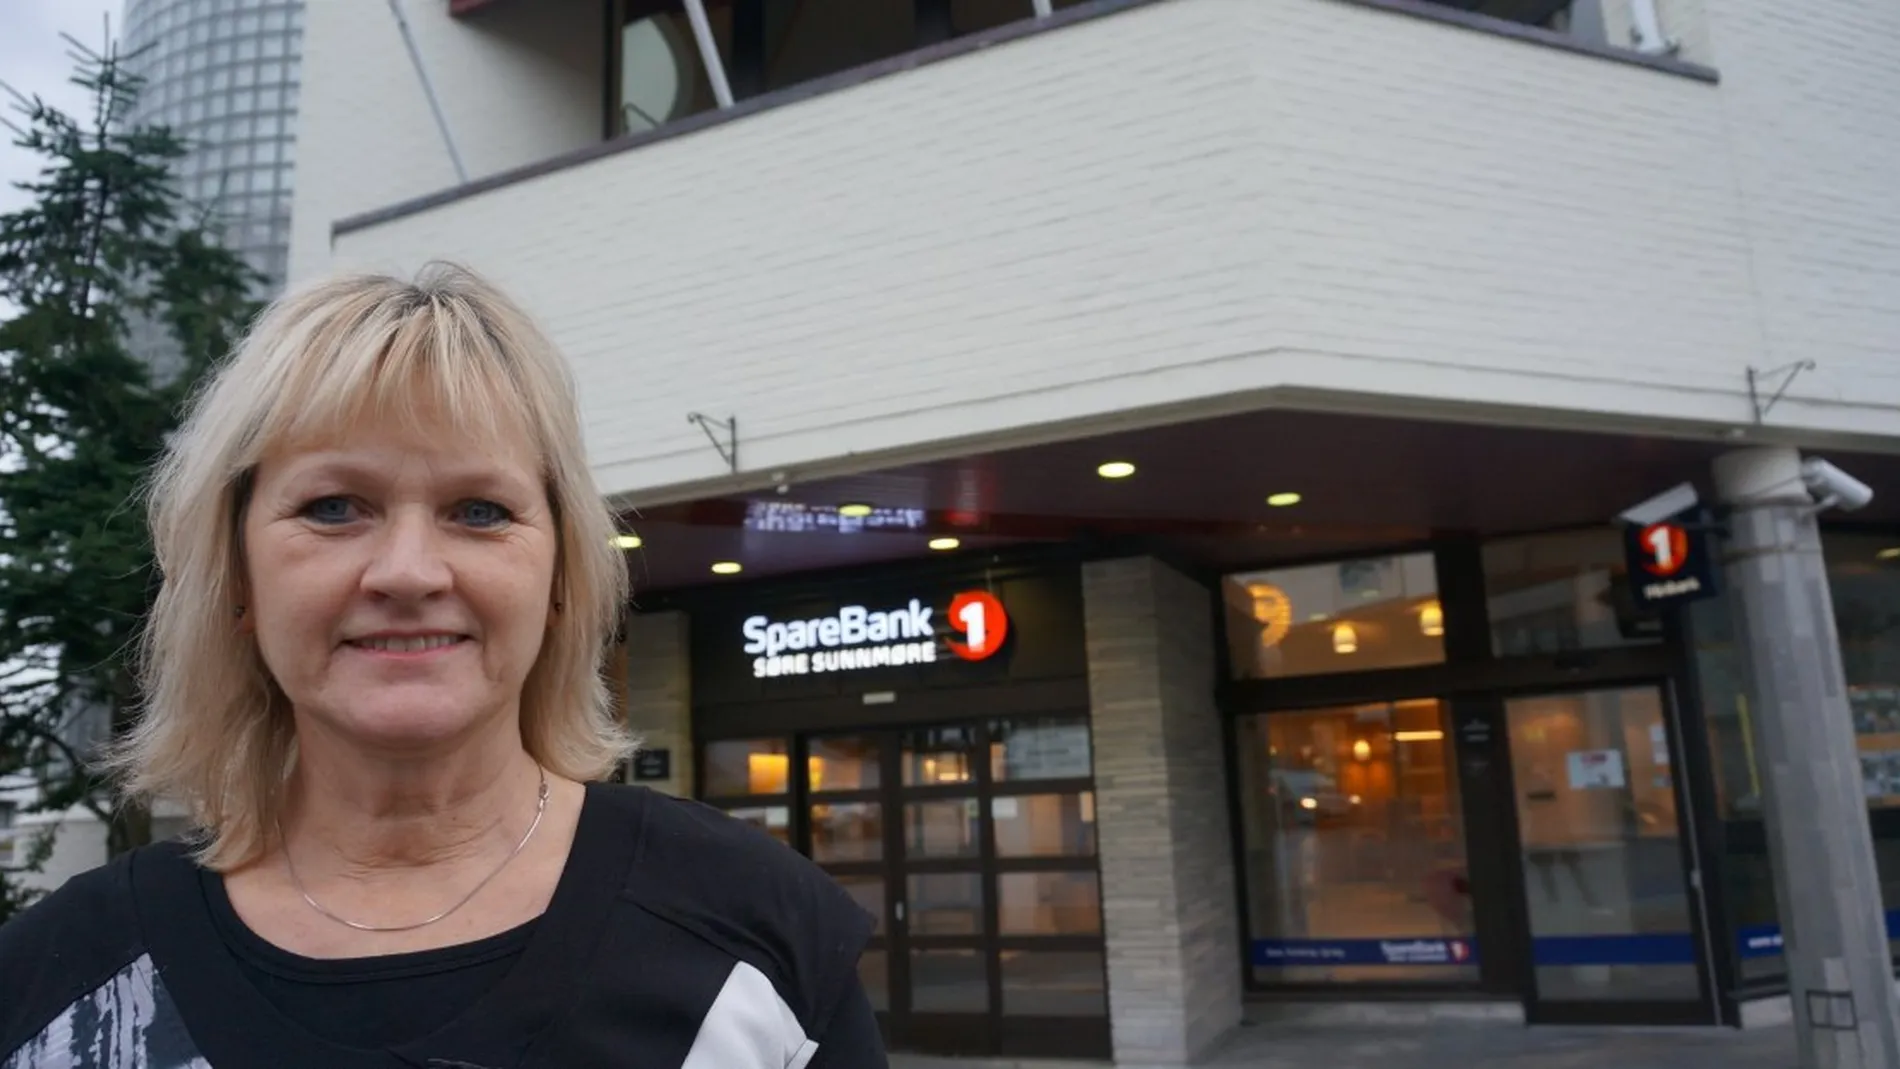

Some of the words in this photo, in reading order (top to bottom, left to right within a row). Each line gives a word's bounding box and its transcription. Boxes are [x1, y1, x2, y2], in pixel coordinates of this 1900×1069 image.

[1649, 526, 1672, 569] 1
[743, 599, 934, 657] SpareBank
[958, 602, 986, 652] 1
[753, 656, 809, 678] SØRE
[812, 641, 937, 673] SUNNMØRE
